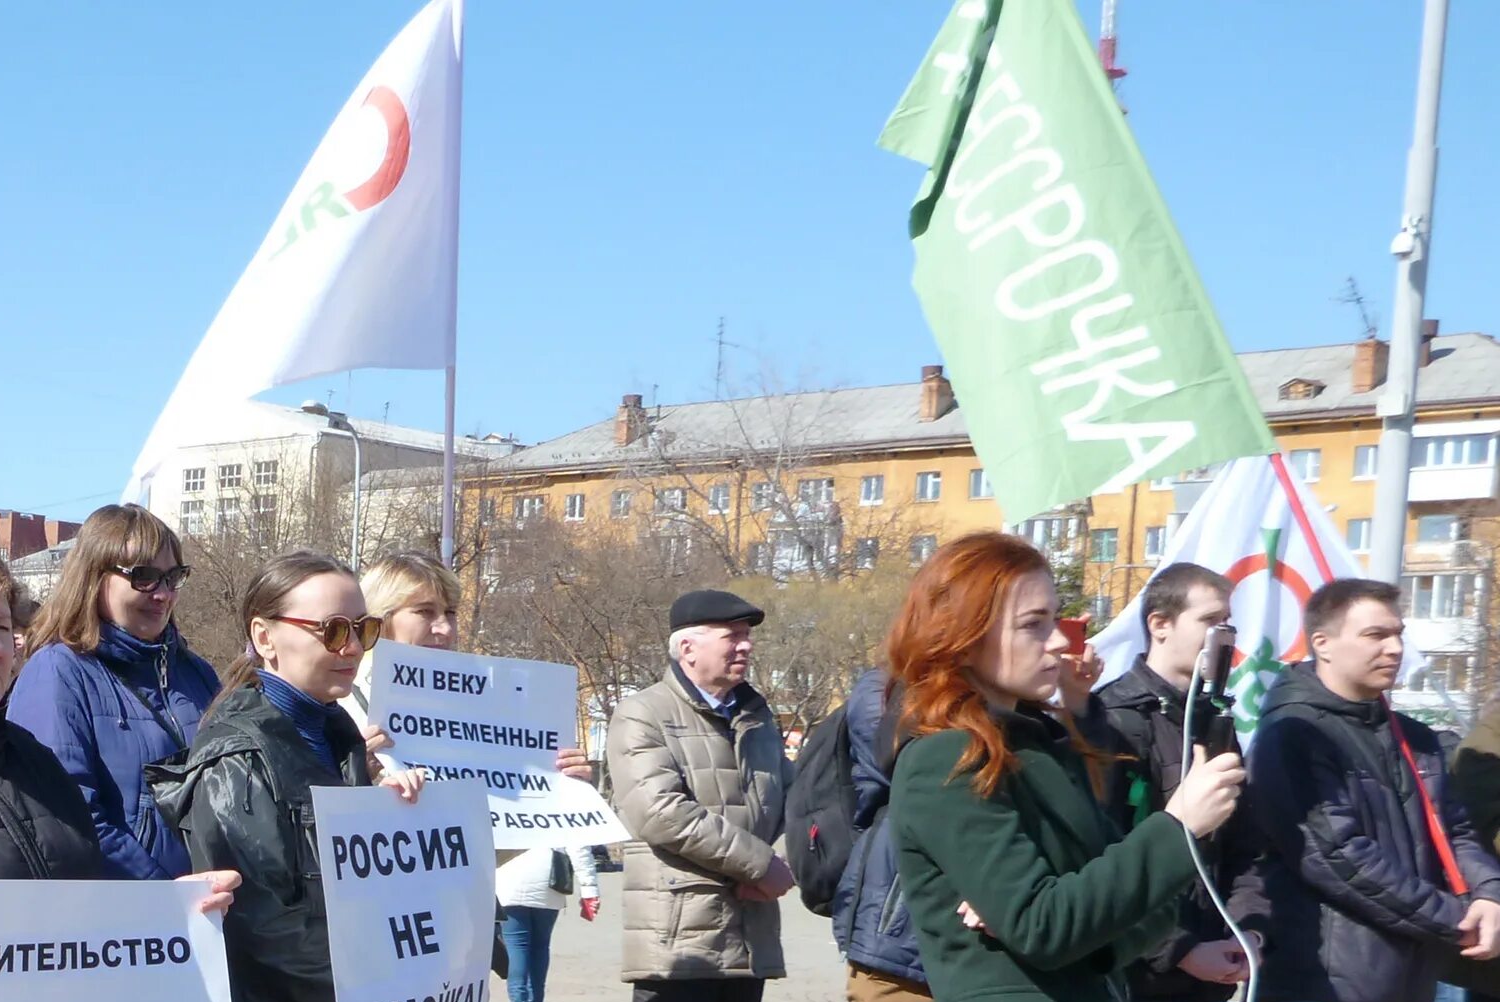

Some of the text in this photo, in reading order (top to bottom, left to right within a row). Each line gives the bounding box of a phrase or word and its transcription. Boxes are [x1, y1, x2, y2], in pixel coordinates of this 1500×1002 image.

[944, 42, 1197, 495] ЕССРОЧКА
[433, 669, 487, 695] ВЕКУ
[389, 712, 558, 751] СОВРЕМЕННЫЕ
[332, 825, 469, 881] РОССИЯ
[388, 911, 440, 960] НЕ
